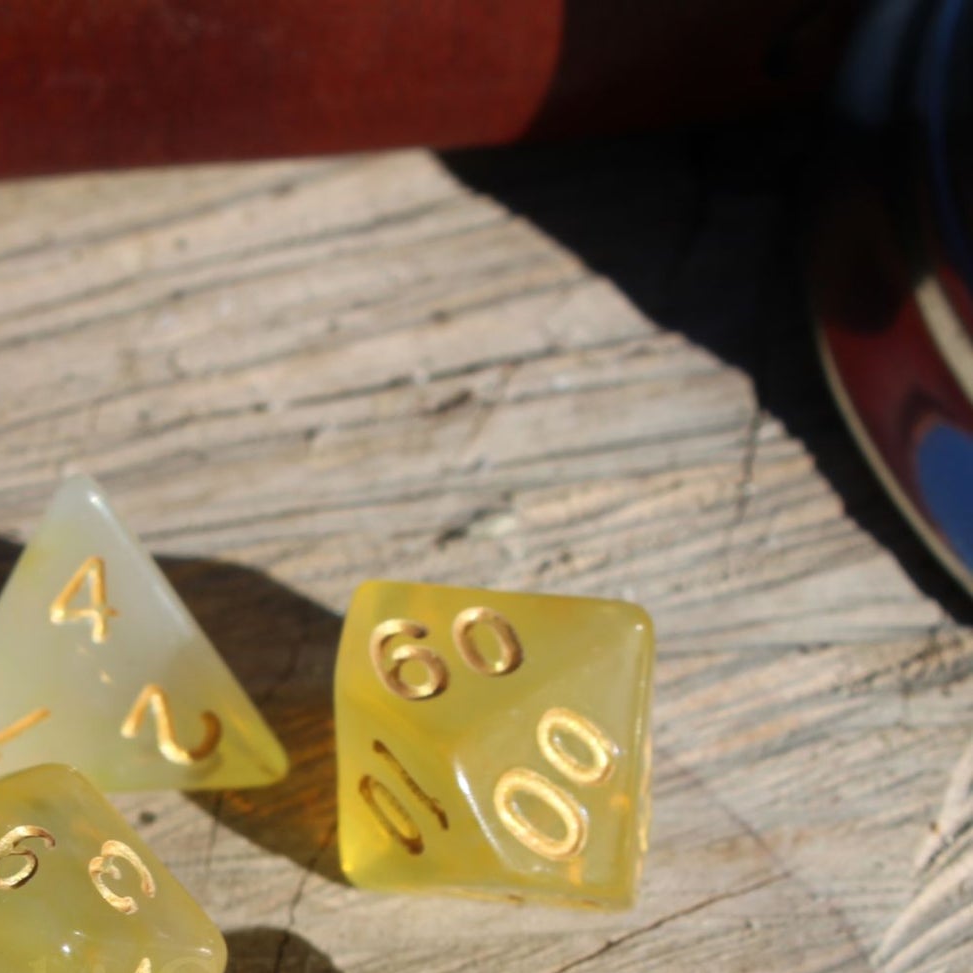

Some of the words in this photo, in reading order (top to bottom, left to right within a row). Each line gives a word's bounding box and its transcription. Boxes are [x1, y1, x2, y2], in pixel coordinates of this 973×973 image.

[49, 556, 119, 644] 4
[369, 606, 525, 701] 60
[121, 684, 222, 766] 2
[493, 707, 618, 861] 00
[89, 839, 157, 915] 3
